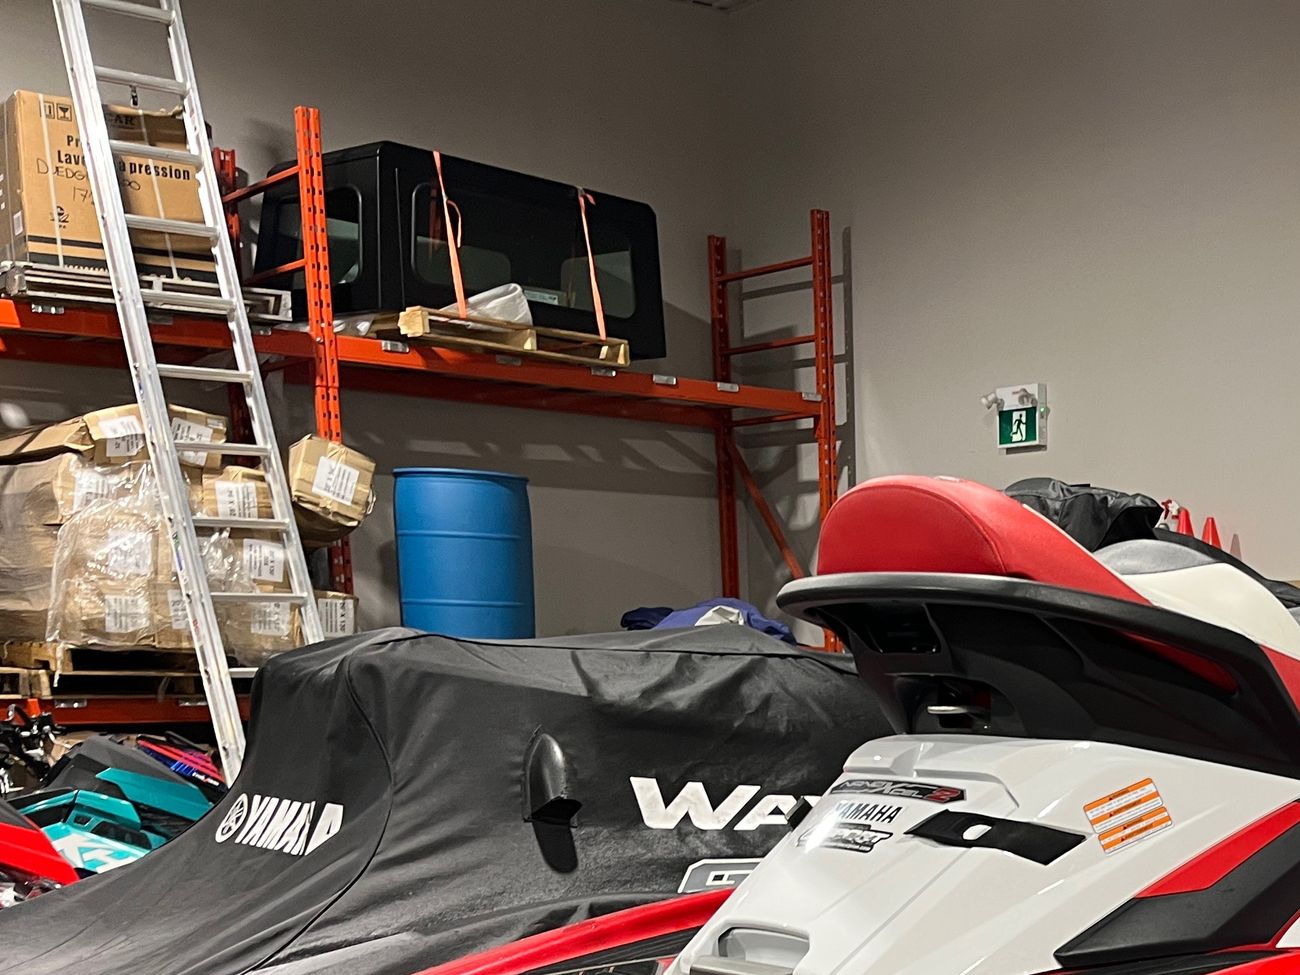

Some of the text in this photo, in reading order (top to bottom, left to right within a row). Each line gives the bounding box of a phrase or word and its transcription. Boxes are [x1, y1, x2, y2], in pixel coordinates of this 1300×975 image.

[66, 134, 81, 148] Pr
[129, 161, 191, 181] pression
[834, 802, 904, 824] YAMAHA
